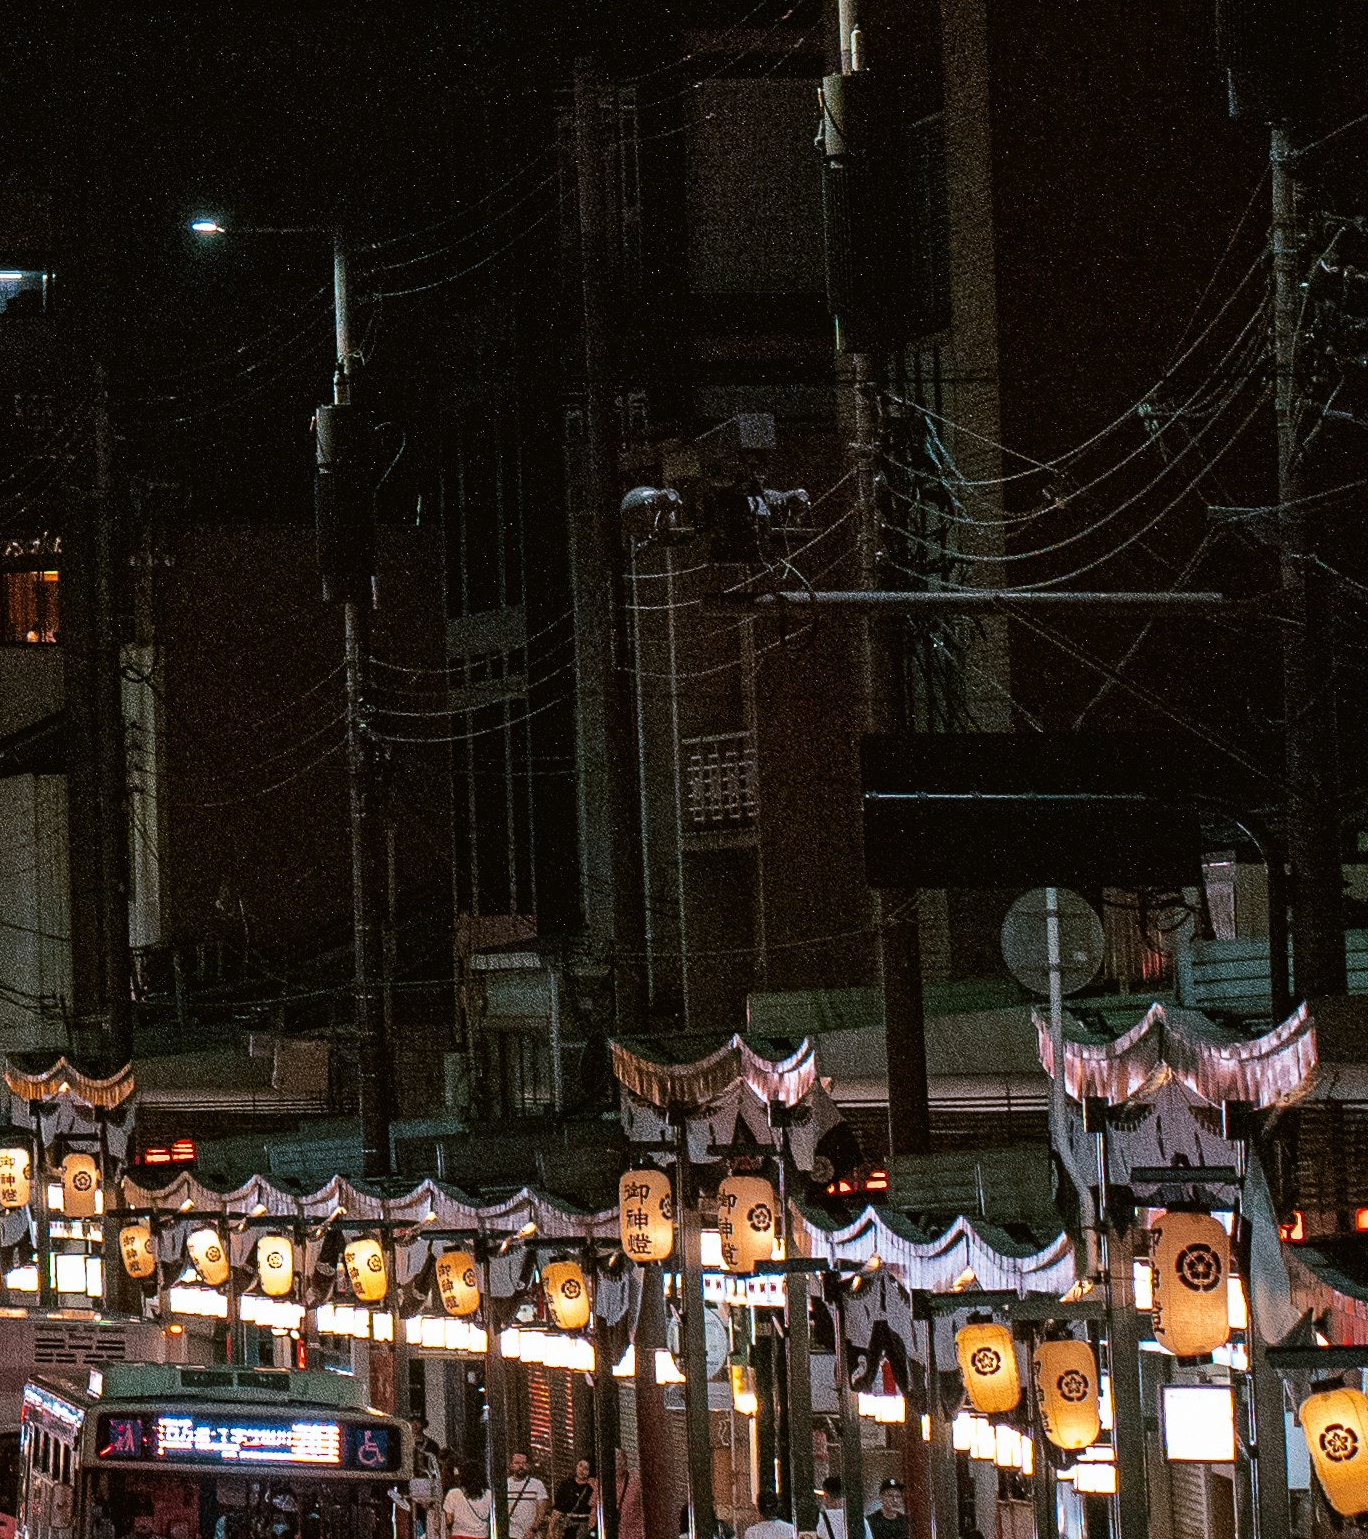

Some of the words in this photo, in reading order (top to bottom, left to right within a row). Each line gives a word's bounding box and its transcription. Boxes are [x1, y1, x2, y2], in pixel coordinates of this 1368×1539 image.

[0, 1155, 18, 1203] 御神燈
[624, 1181, 653, 1256] 御神燈
[438, 1264, 460, 1310] 御神燈
